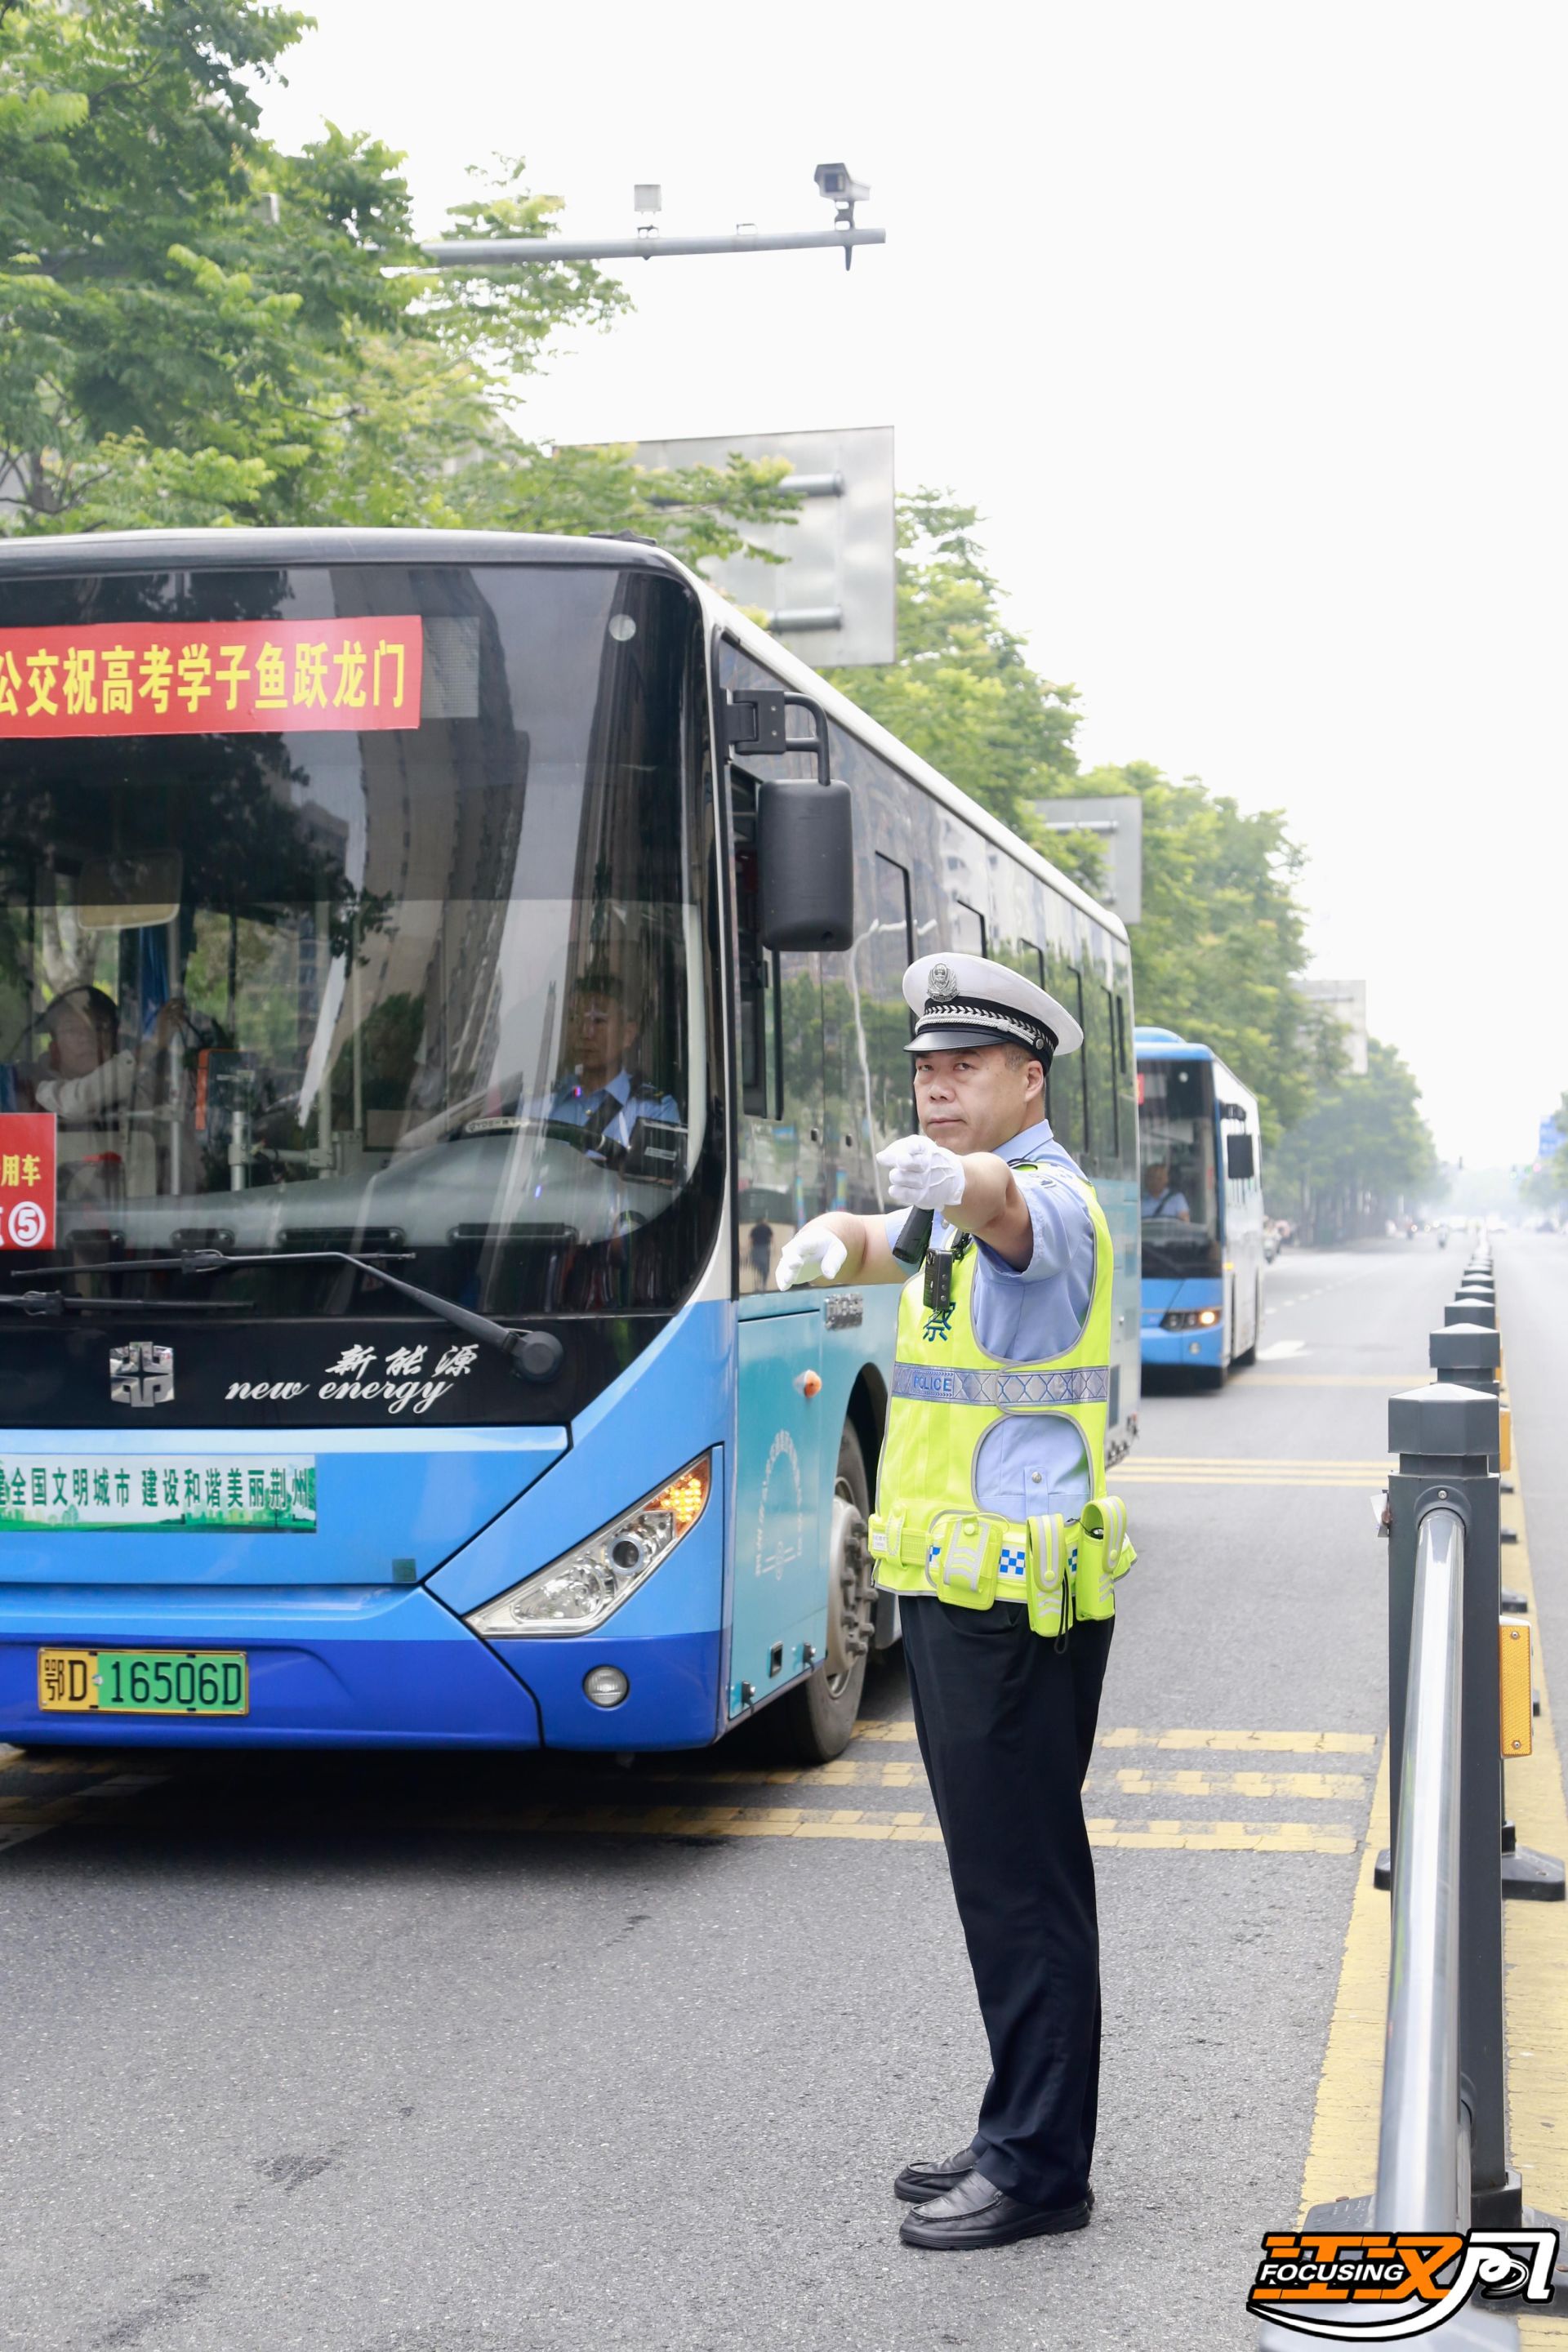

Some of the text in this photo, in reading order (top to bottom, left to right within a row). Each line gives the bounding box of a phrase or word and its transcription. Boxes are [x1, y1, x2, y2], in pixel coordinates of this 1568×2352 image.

[0, 639, 406, 717] 公交祝高考学子鱼跃龙门
[325, 1343, 479, 1380] 新能源
[225, 1381, 456, 1414] new energy
[913, 1374, 953, 1392] POLICE
[141, 1467, 309, 1509] 建设和谐美丽荆州
